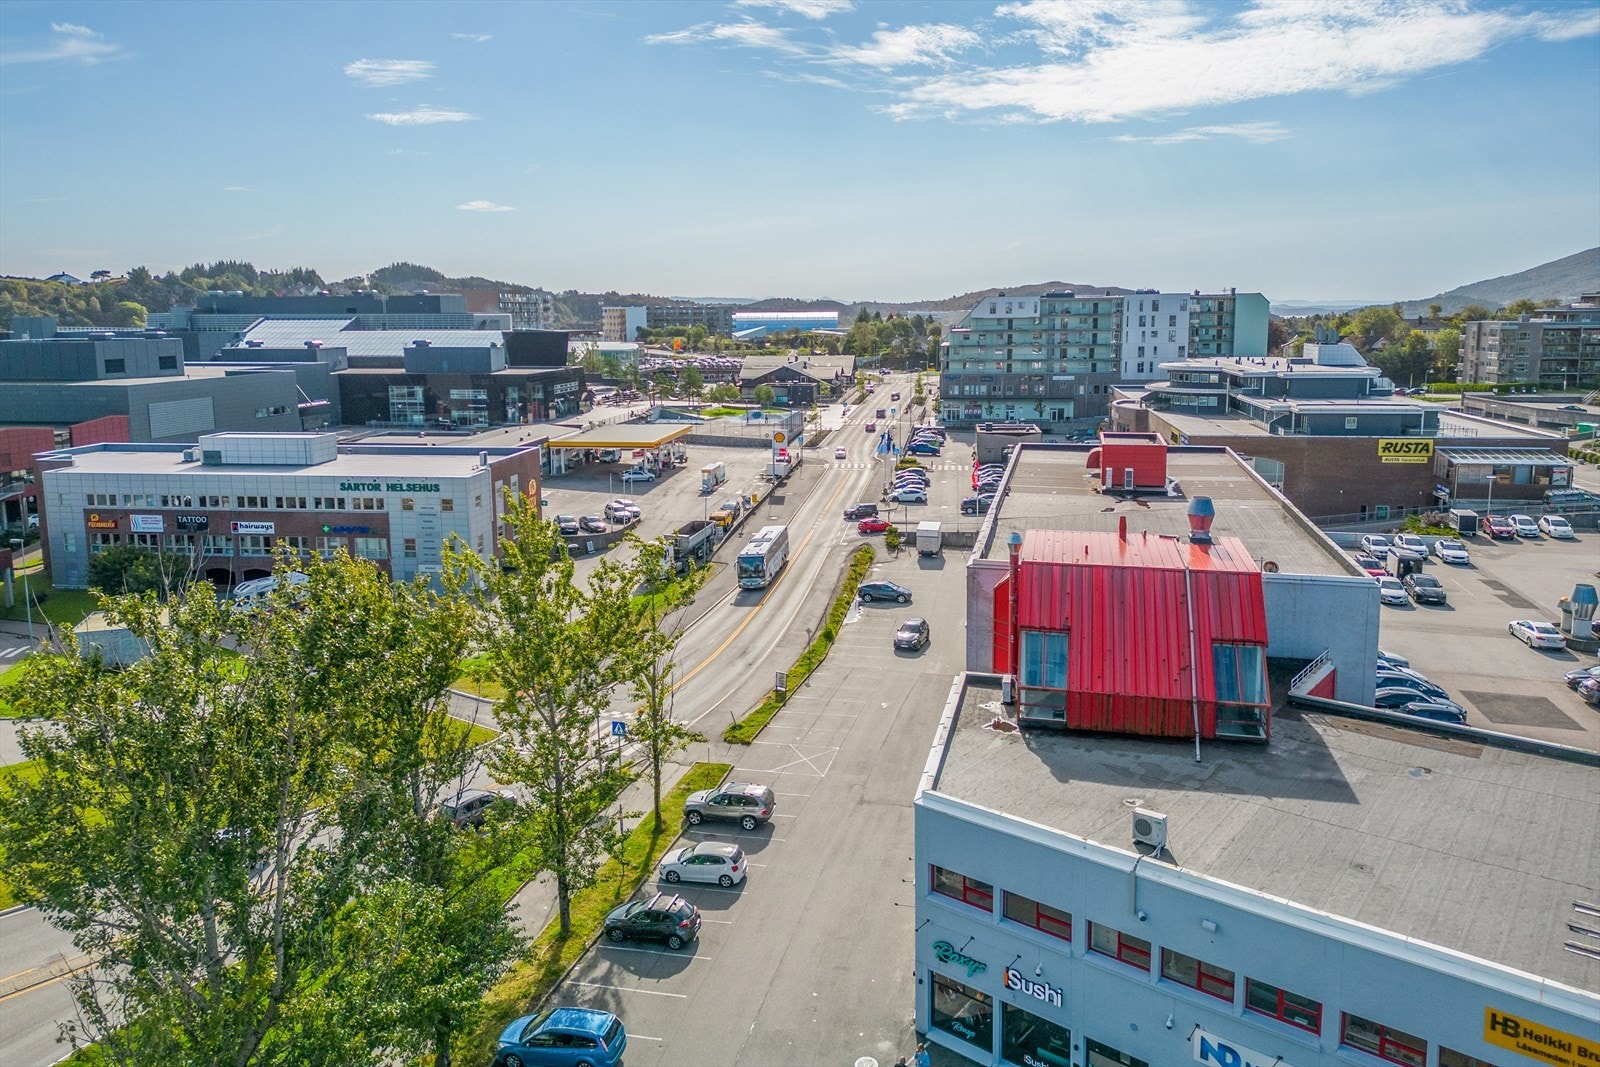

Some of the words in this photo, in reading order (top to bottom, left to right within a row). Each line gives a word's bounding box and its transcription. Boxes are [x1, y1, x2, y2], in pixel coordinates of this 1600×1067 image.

[1381, 442, 1430, 453] RUSTA
[386, 483, 440, 492] HELSEHUS
[239, 523, 273, 531] hairways
[1490, 1012, 1521, 1039] HB
[1523, 1027, 1572, 1053] Heikki
[1024, 1054, 1049, 1067] iSush
